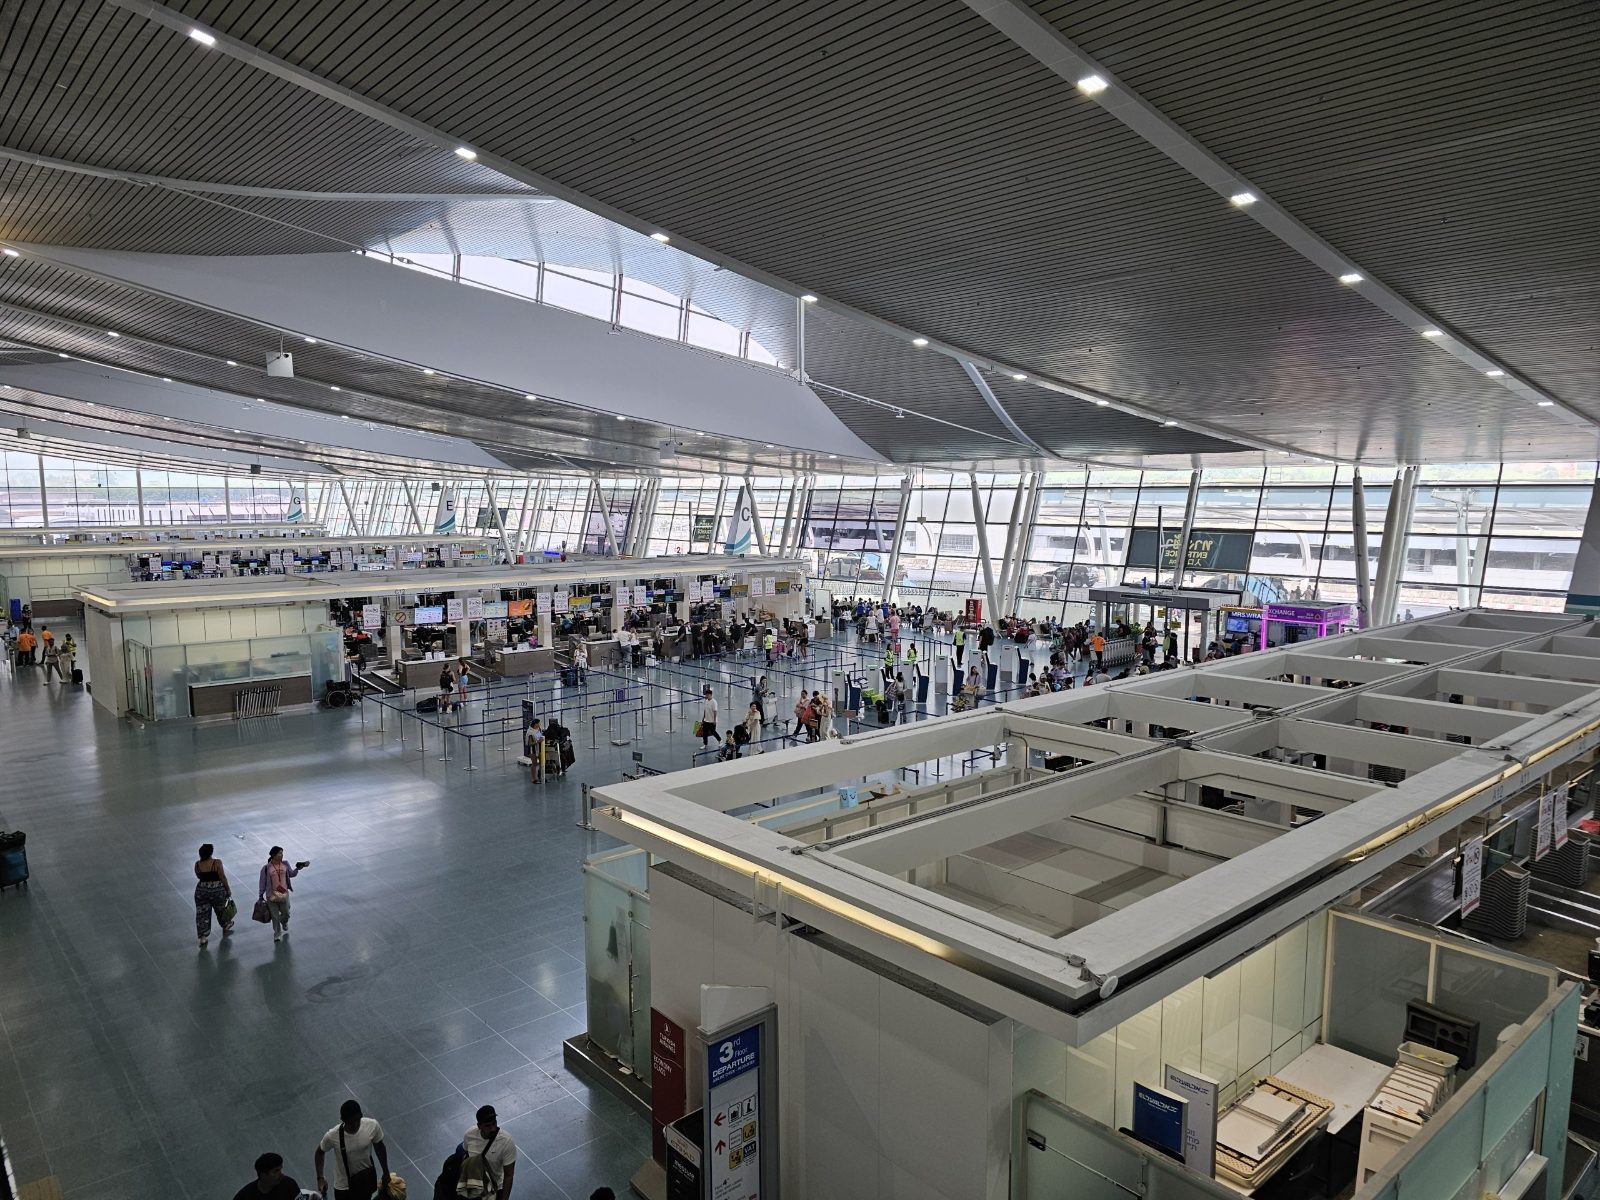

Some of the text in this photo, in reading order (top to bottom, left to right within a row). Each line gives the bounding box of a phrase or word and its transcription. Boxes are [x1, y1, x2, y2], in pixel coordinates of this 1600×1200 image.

[293, 496, 301, 505] G
[446, 500, 453, 511] E
[741, 507, 750, 521] C
[1267, 608, 1295, 616] XCHANGE
[1492, 785, 1504, 801] A12
[653, 1055, 672, 1074] ECONOMY
[712, 1052, 756, 1078] DEPARTURE
